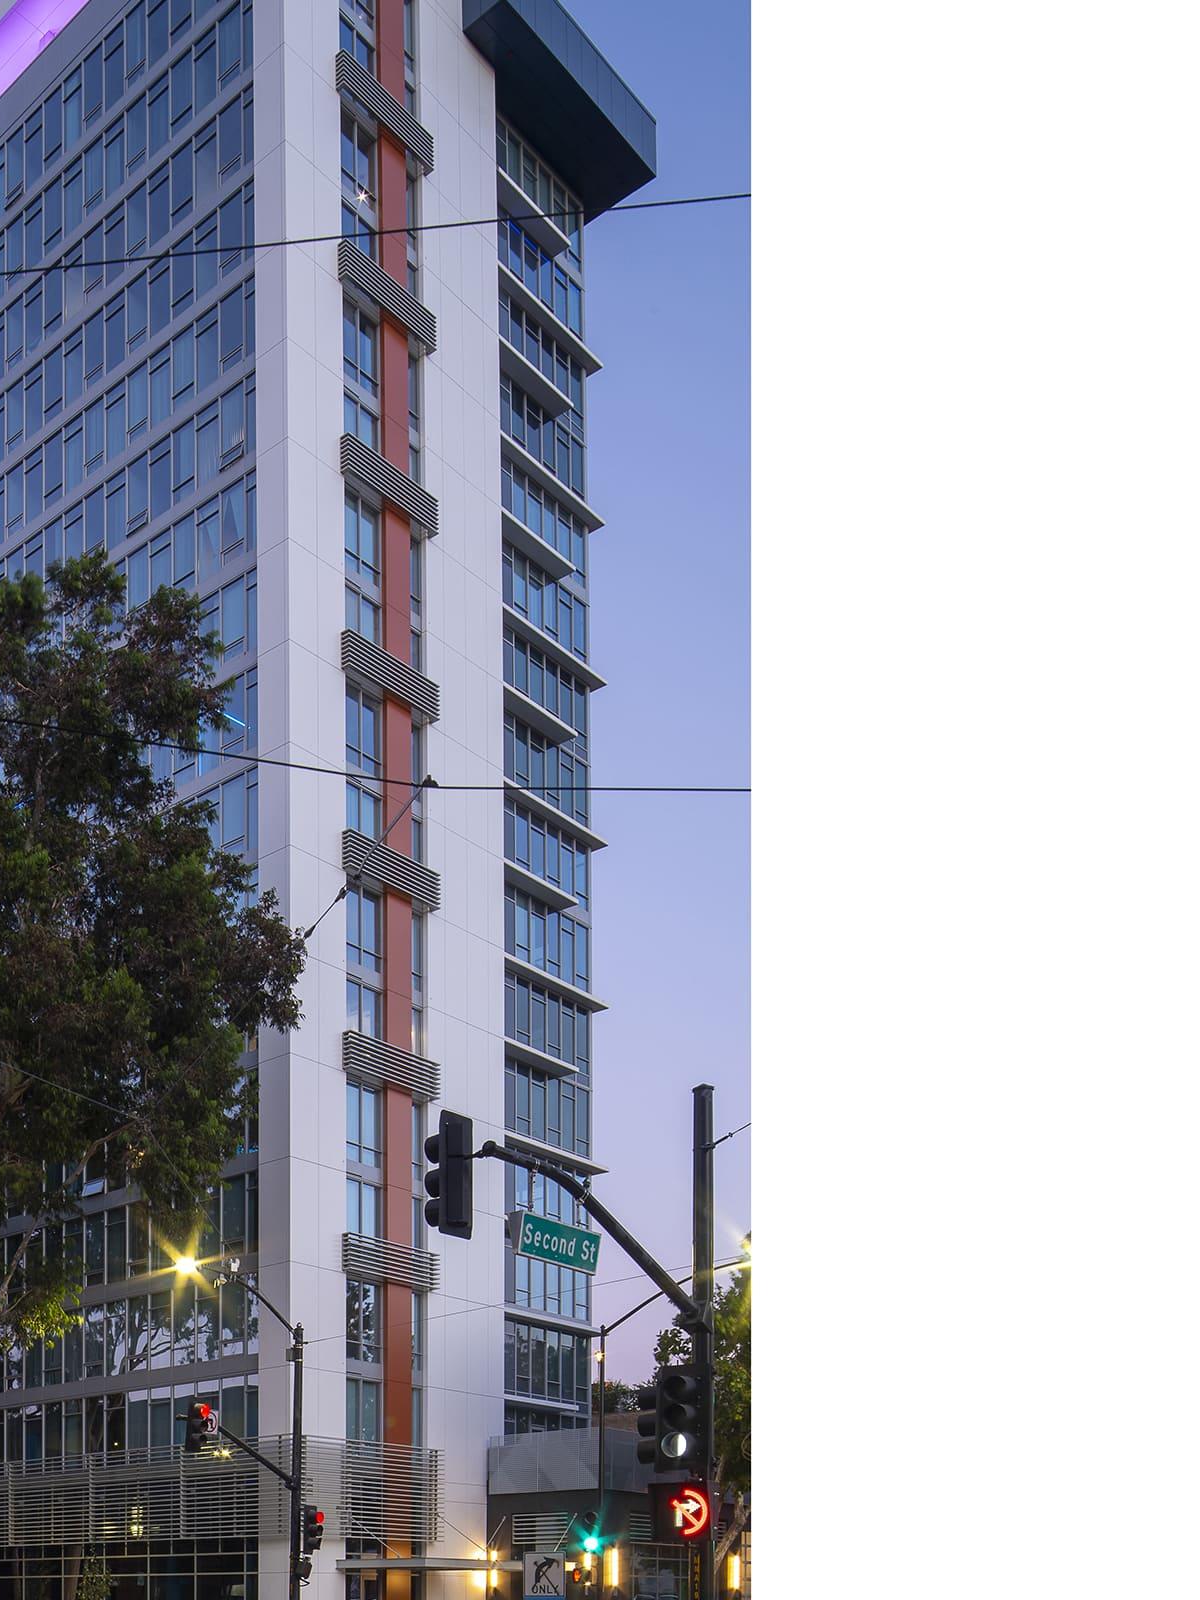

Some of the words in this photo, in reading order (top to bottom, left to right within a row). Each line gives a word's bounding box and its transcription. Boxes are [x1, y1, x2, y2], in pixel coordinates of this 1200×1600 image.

[524, 1223, 577, 1257] Second
[581, 1240, 596, 1263] St
[532, 1584, 559, 1594] ONLY
